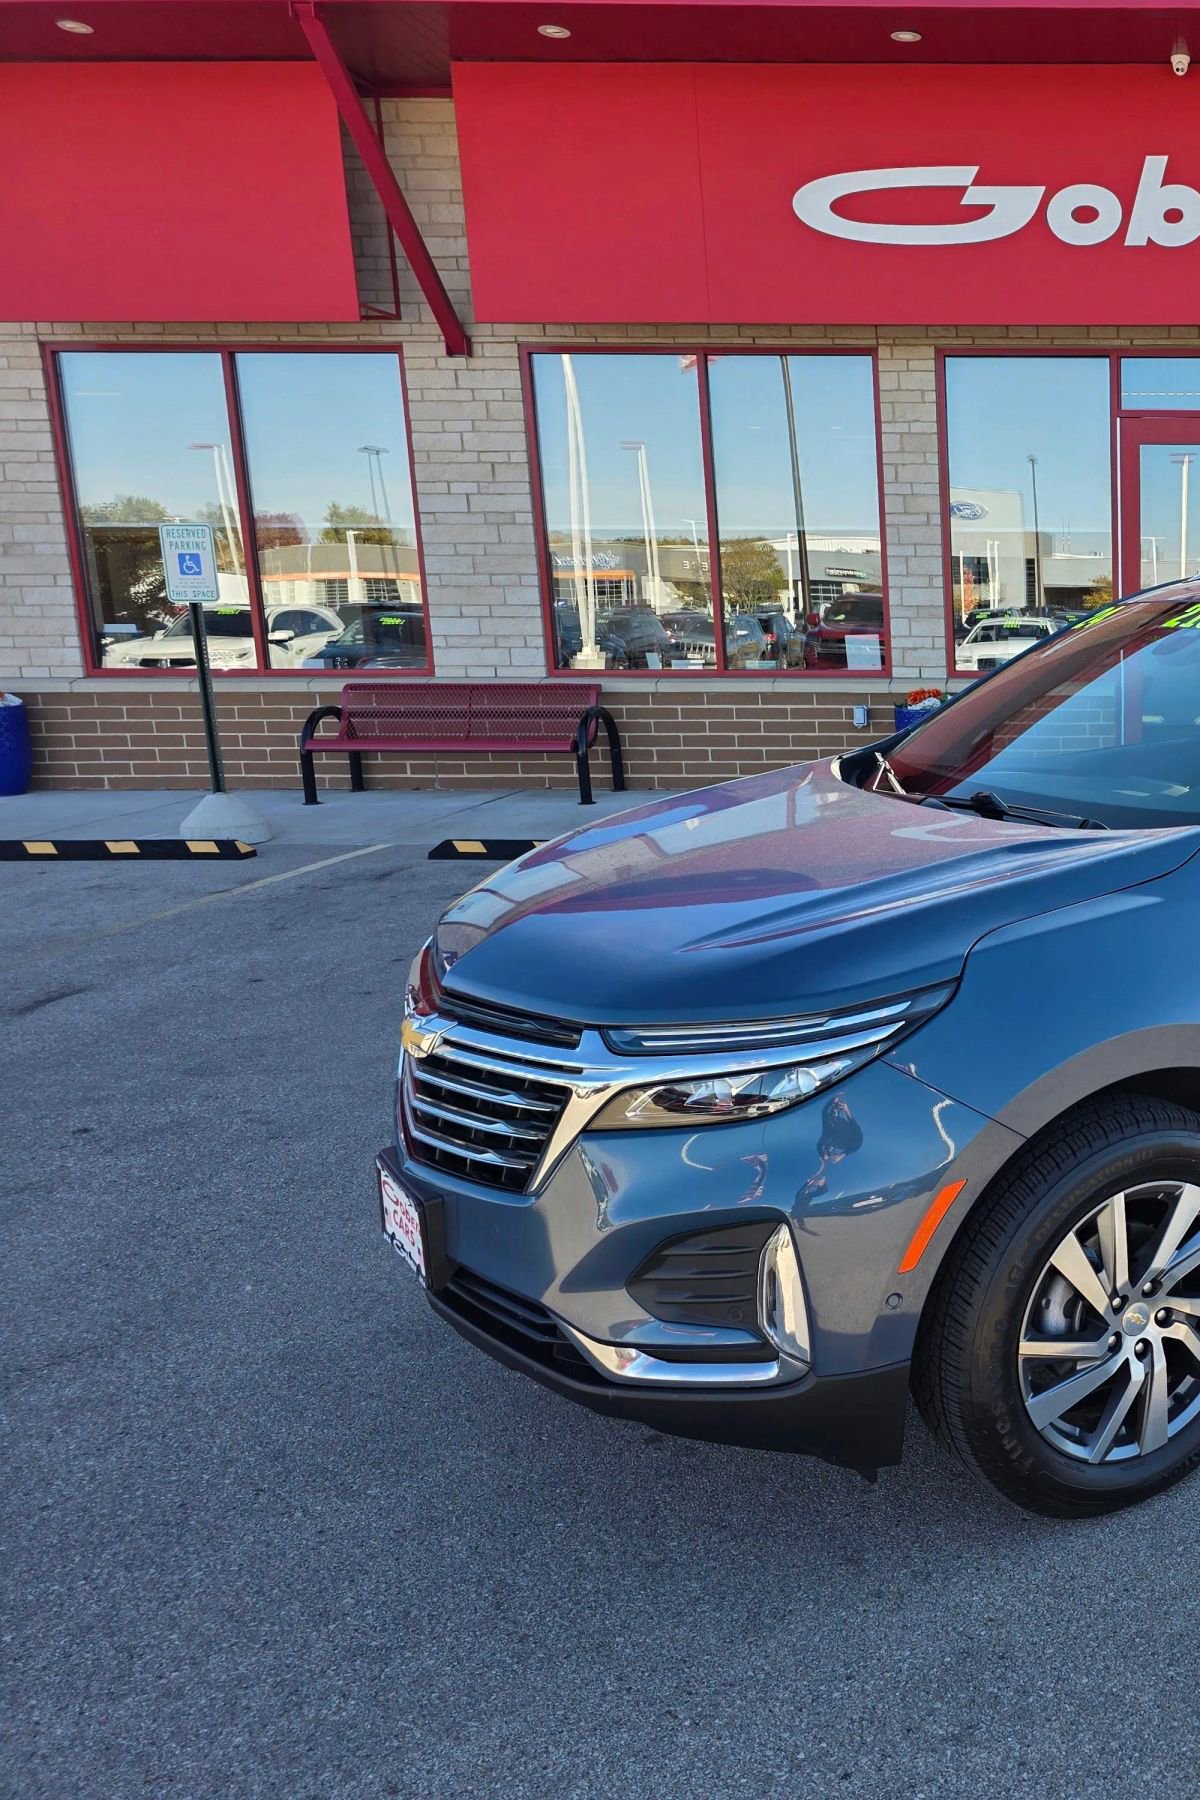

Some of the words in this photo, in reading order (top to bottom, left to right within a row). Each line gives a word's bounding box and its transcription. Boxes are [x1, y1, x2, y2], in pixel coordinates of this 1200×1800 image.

[165, 528, 207, 539] RESERVED
[169, 541, 207, 551] PARKING
[171, 590, 189, 598] THIS
[192, 590, 216, 598] SPACE
[393, 1208, 416, 1248] CARS
